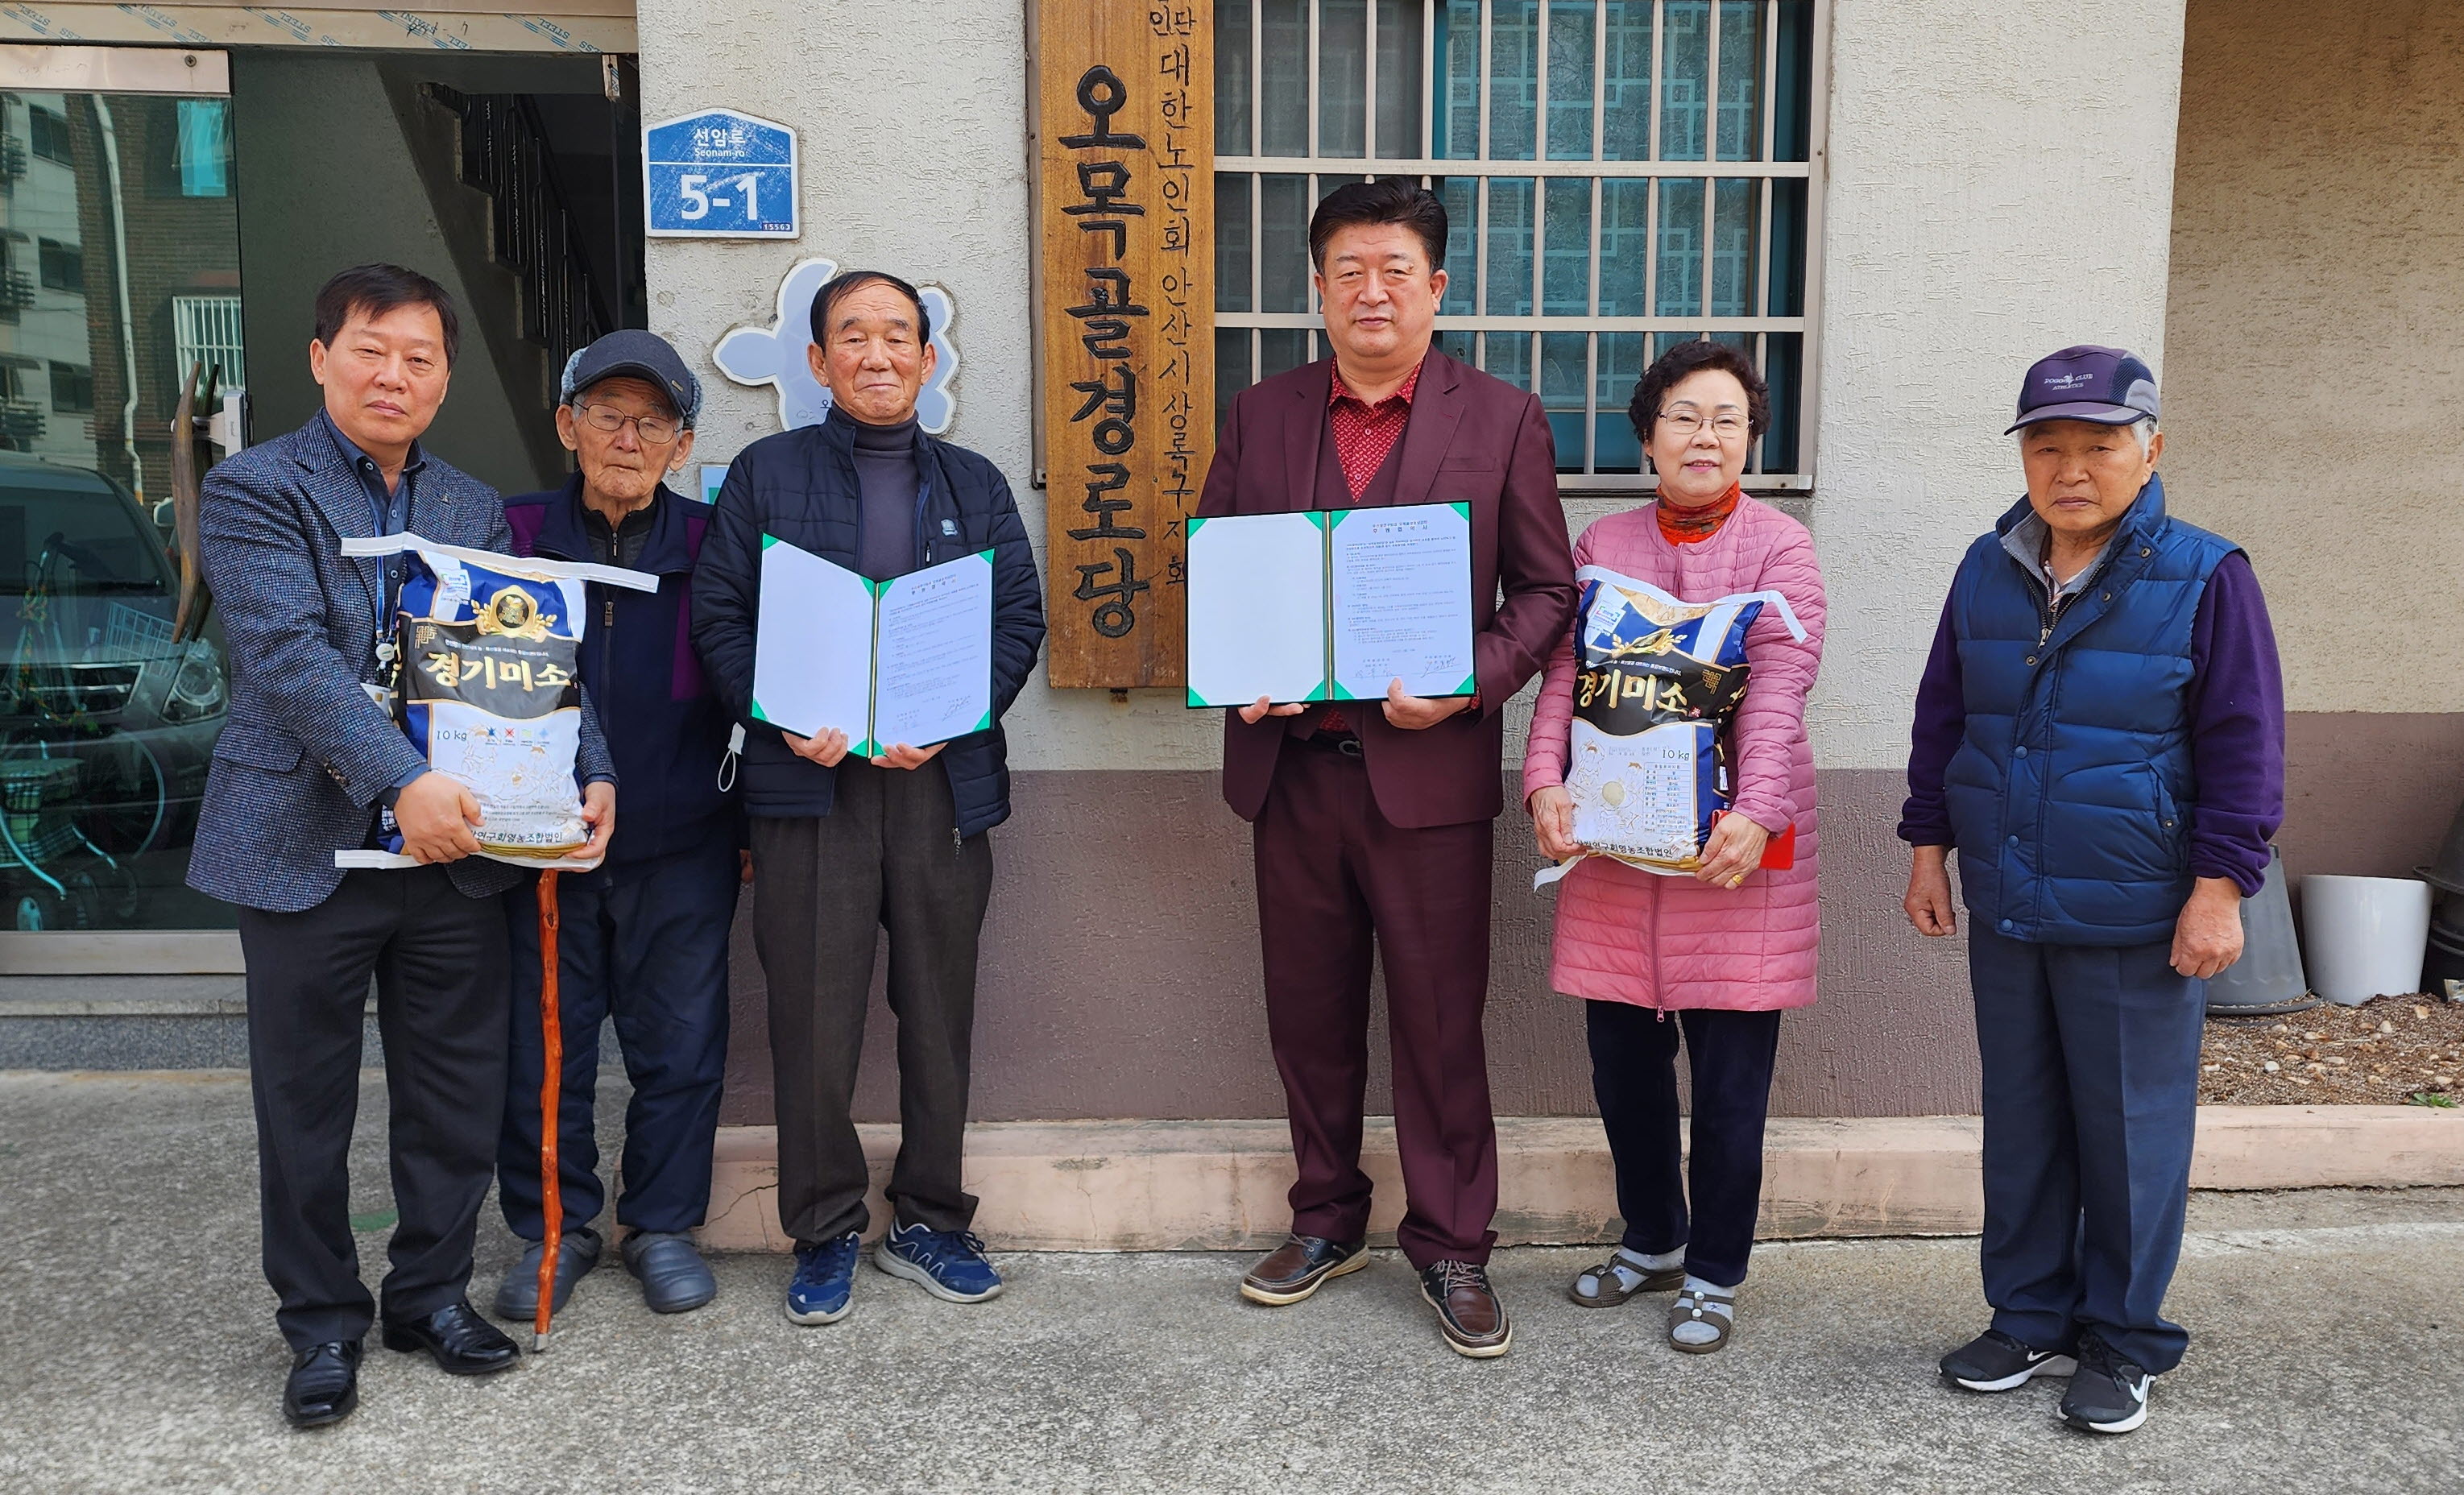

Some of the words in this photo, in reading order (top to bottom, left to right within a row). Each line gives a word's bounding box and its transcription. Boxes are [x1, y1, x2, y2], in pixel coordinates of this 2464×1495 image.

[694, 126, 746, 147] 선암로
[694, 147, 745, 157] Seonam-ro
[1158, 43, 1194, 259] 대한노인회
[681, 174, 758, 221] 5-1
[764, 223, 791, 231] 15563
[1158, 267, 1193, 387] 안산시
[1058, 65, 1150, 639] 오목골경로당
[425, 652, 572, 692] 경기미소
[1578, 669, 1688, 716] 경기미소
[437, 731, 450, 740] 10
[453, 730, 467, 741] kg
[1663, 749, 1675, 759] 10
[1678, 750, 1690, 760] kg
